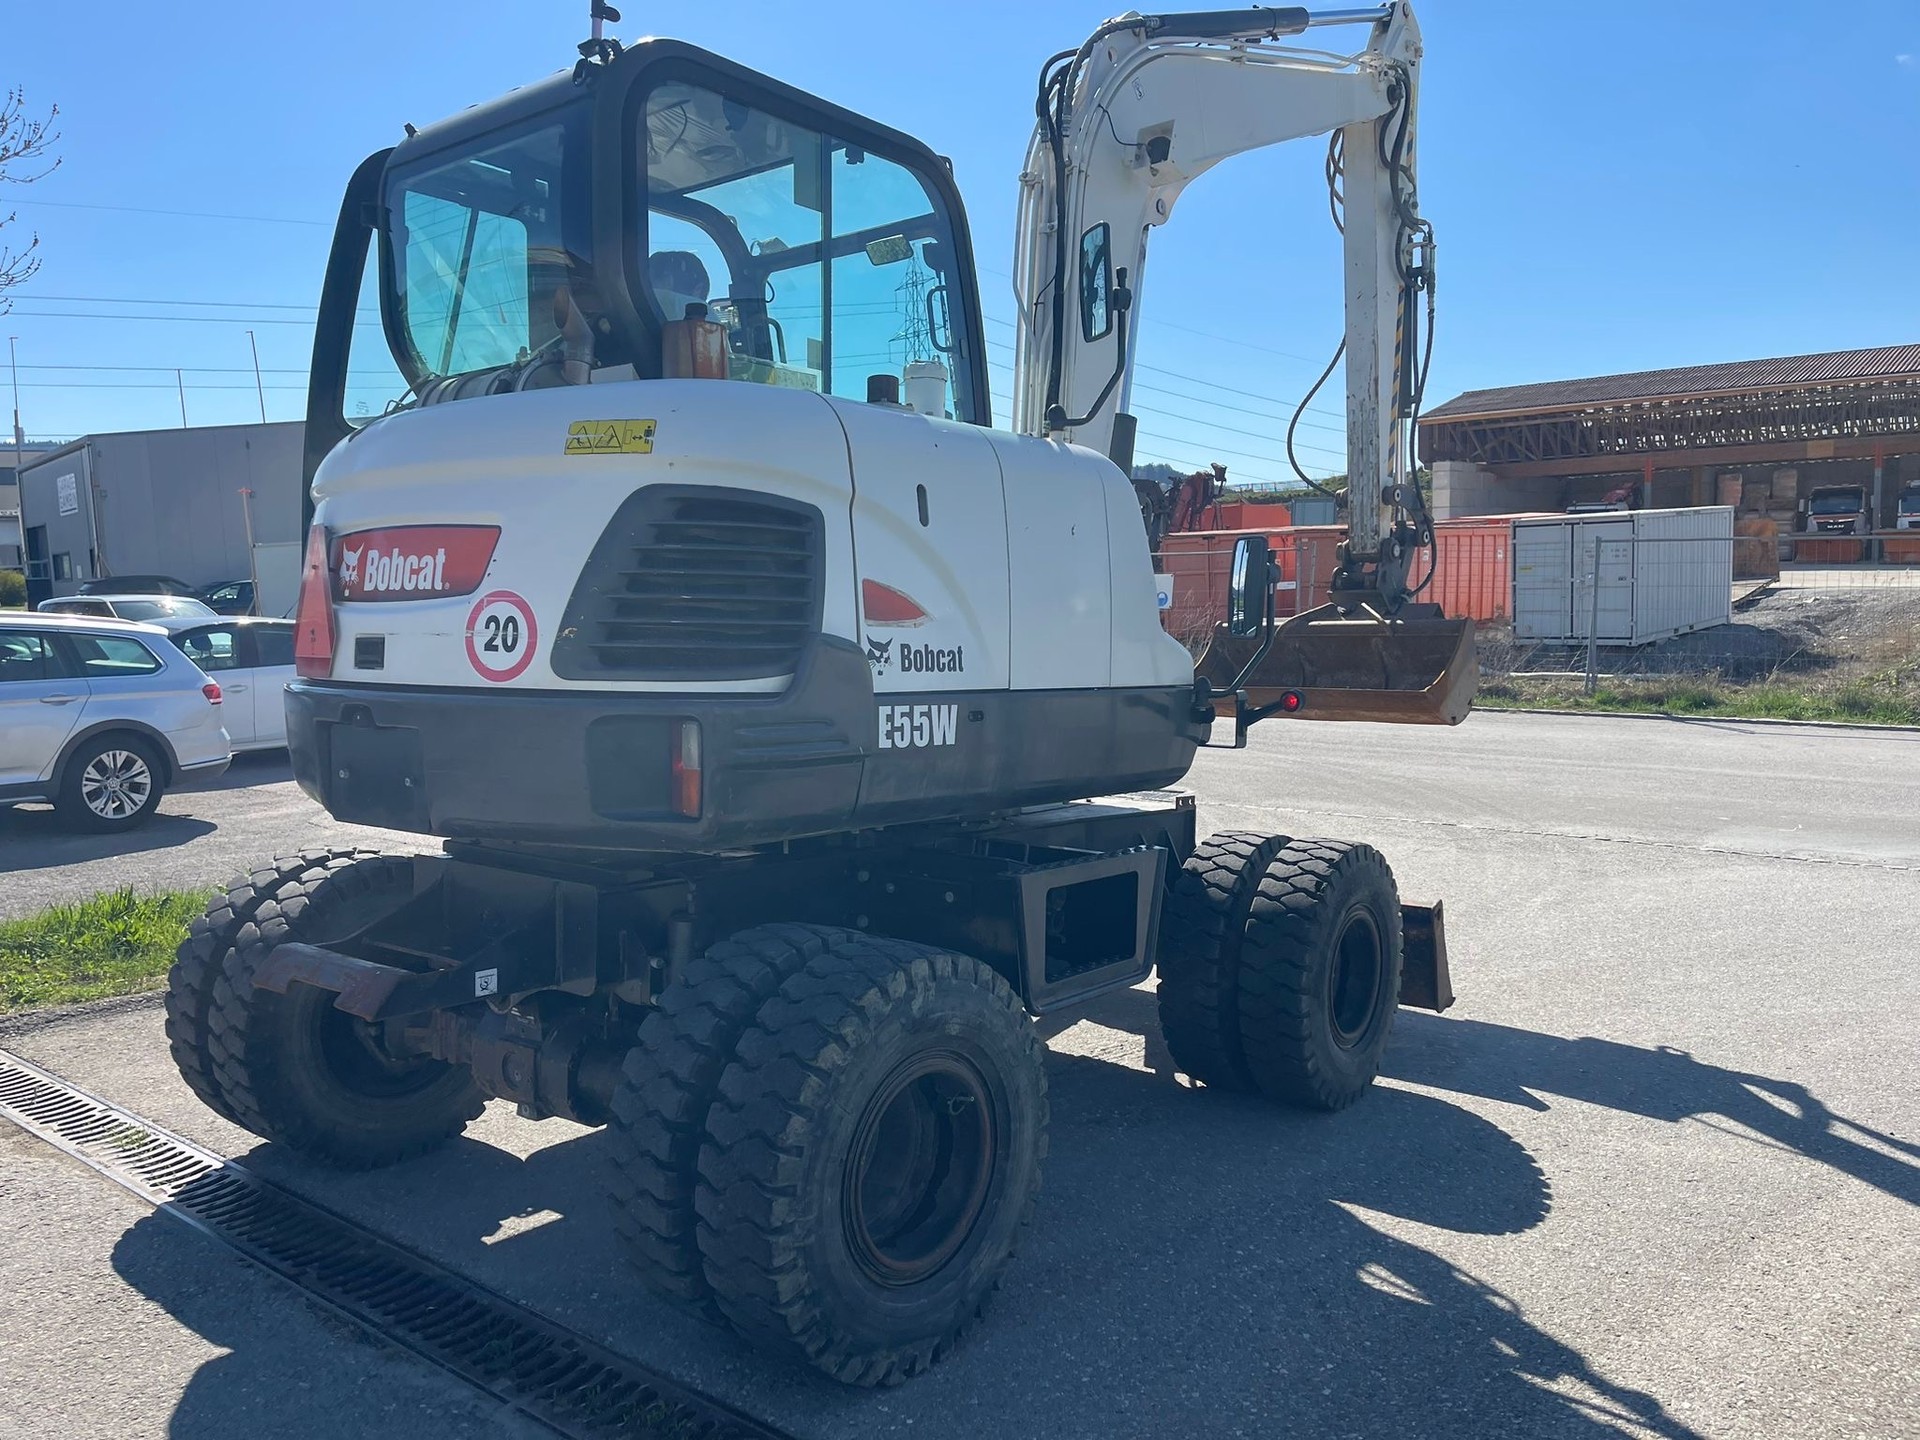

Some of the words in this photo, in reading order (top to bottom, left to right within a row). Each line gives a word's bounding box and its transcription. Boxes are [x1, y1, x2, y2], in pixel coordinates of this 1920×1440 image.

[364, 548, 446, 591] Bobcat
[484, 615, 518, 653] 20
[900, 643, 964, 672] Bobcat
[878, 704, 958, 748] E55W
